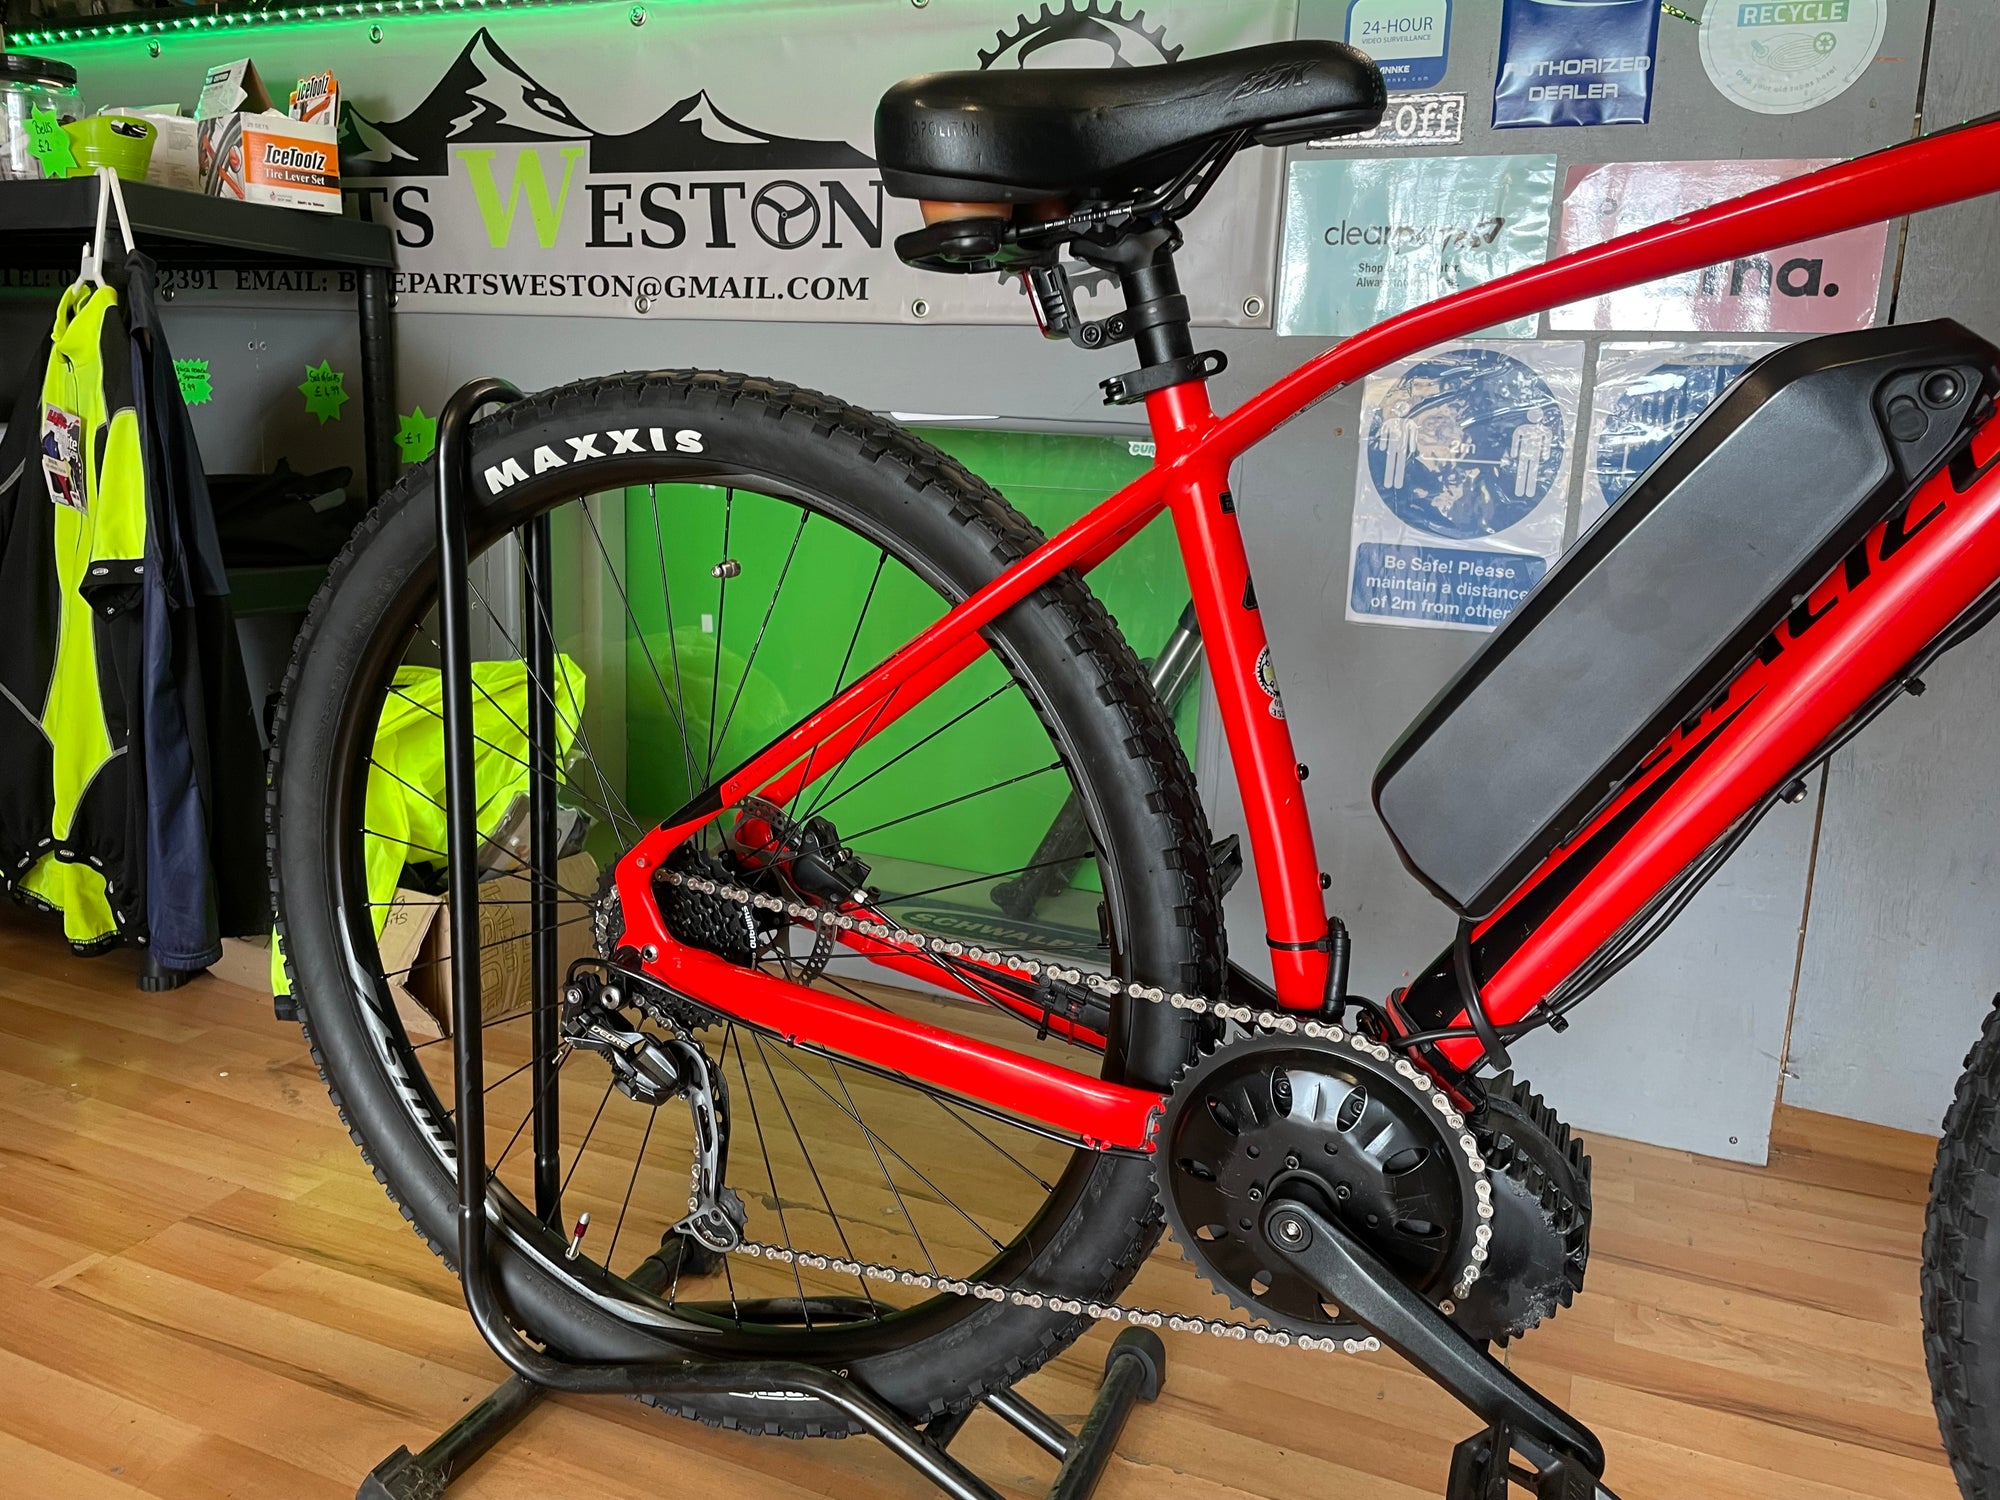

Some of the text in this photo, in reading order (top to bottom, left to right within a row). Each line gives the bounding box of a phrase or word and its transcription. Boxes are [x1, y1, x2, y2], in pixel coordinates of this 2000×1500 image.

[1362, 16, 1433, 35] 24-HOUR
[1743, 3, 1843, 24] RECYCLE
[1383, 34, 1431, 43] SURVEILLANCE
[1503, 56, 1651, 77] AUTHORIZED
[297, 76, 329, 102] IceToolz
[1528, 83, 1619, 102] DEALER
[265, 144, 326, 171] IceToolz
[265, 167, 325, 186] Tire Lever Set
[456, 147, 884, 250] WESTON
[236, 271, 328, 292] EMAIL:
[338, 272, 869, 301] BEPARTSWESTON@GMAIL.COM
[1450, 440, 1476, 454] 2m
[484, 427, 704, 495] MAXXIS
[1384, 555, 1515, 579] Be Safe! Please
[1366, 576, 1528, 600] maintain a distance
[1371, 597, 1512, 619] of 2m from other
[741, 905, 756, 949] SHIMANO
[590, 1025, 631, 1050] DEORE
